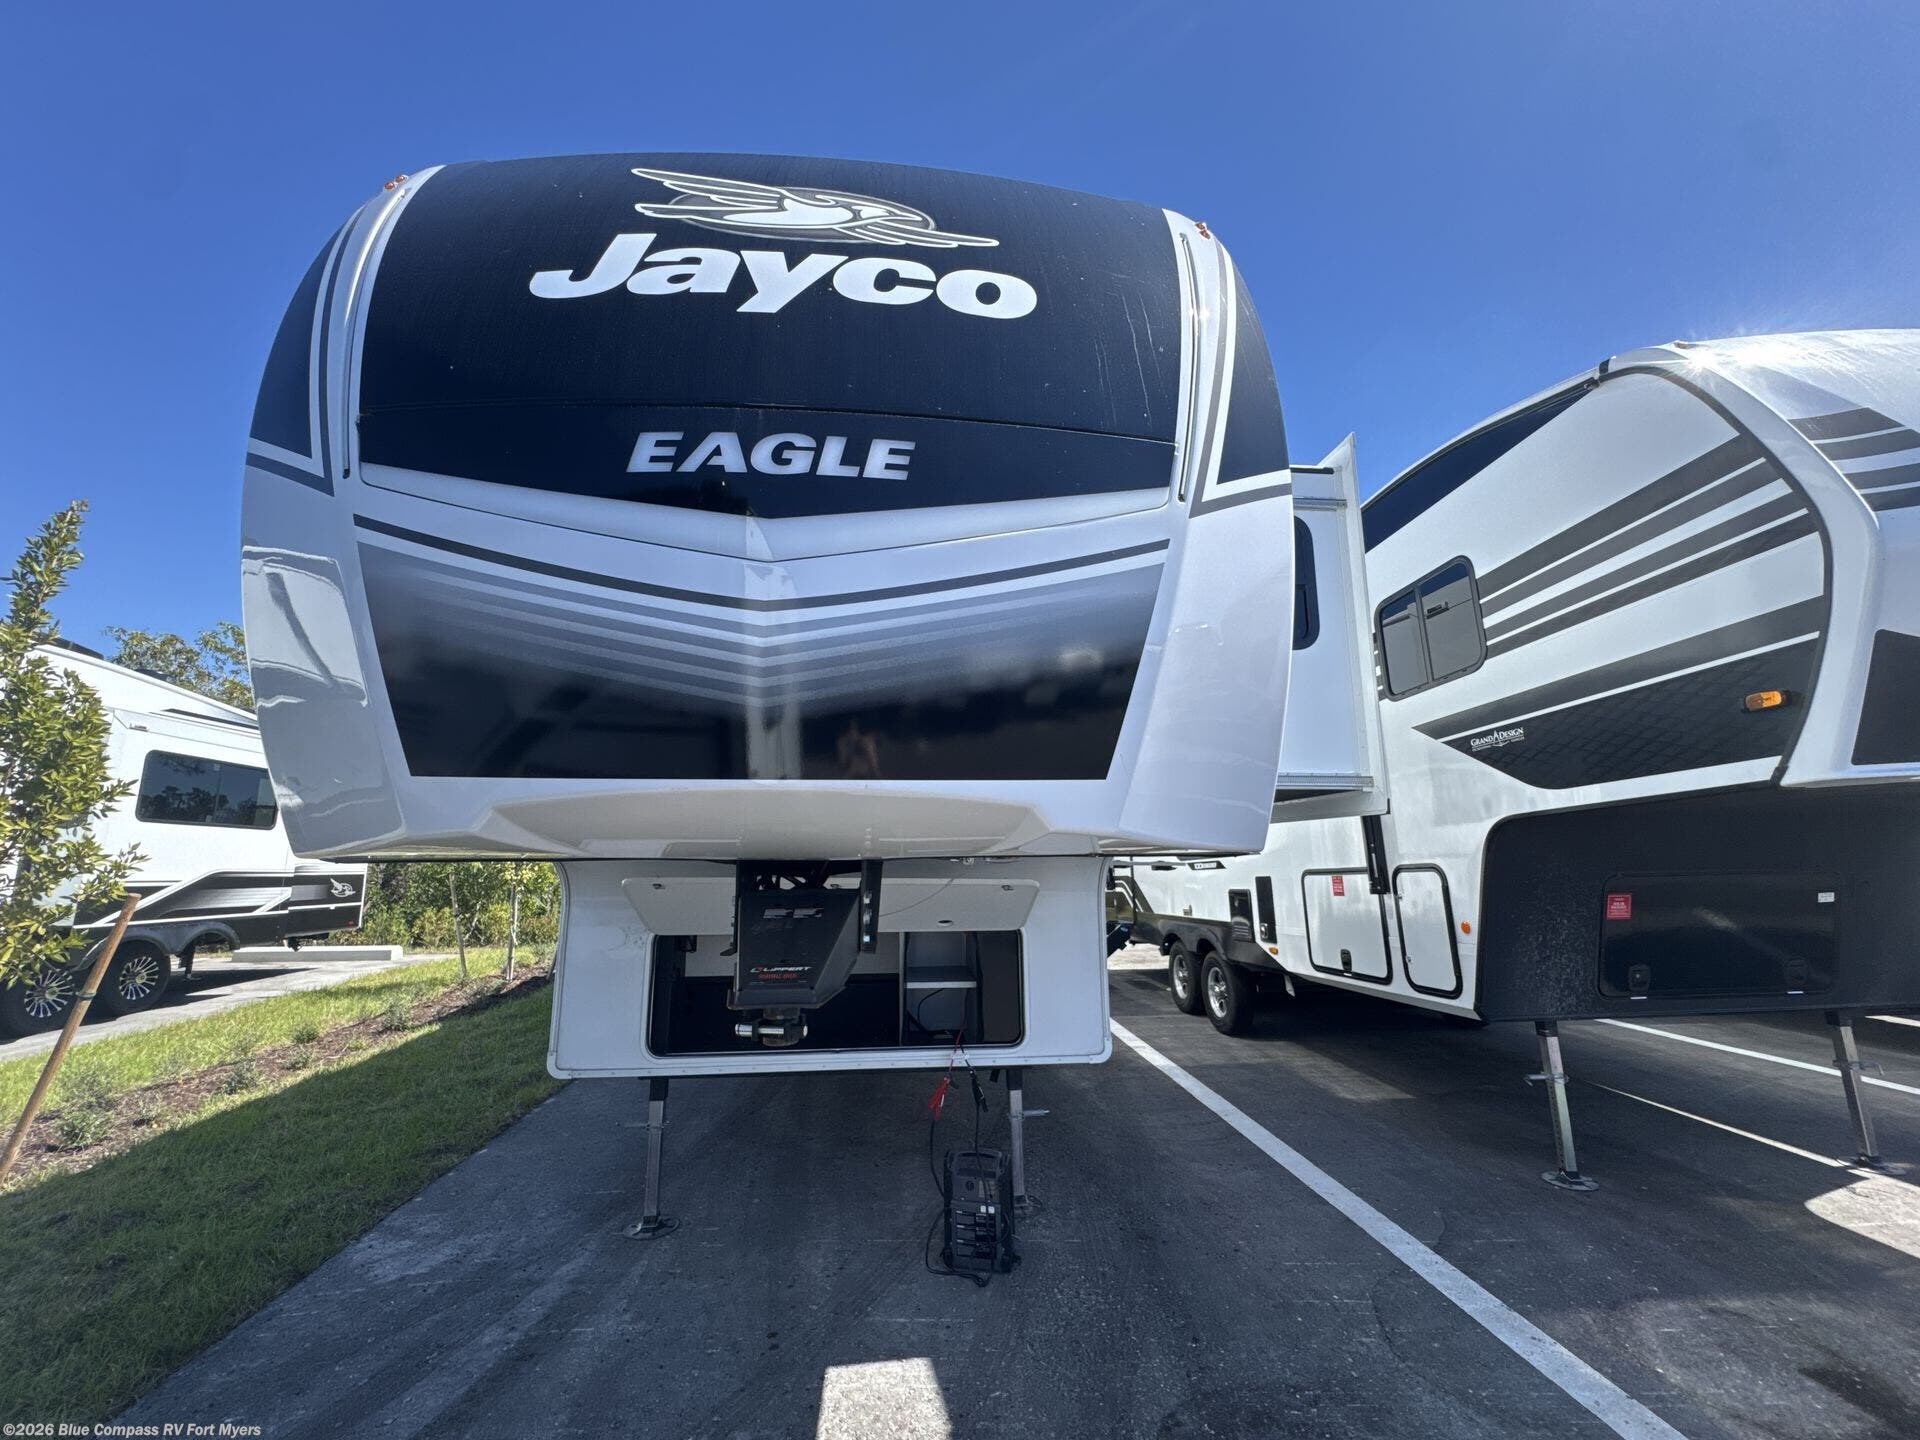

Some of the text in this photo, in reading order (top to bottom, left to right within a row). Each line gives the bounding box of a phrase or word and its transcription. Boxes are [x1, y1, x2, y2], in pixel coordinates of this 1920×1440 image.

[529, 233, 1038, 320] Jayco
[626, 431, 916, 481] EAGLE
[1470, 727, 1524, 746] GRAND DESIGN
